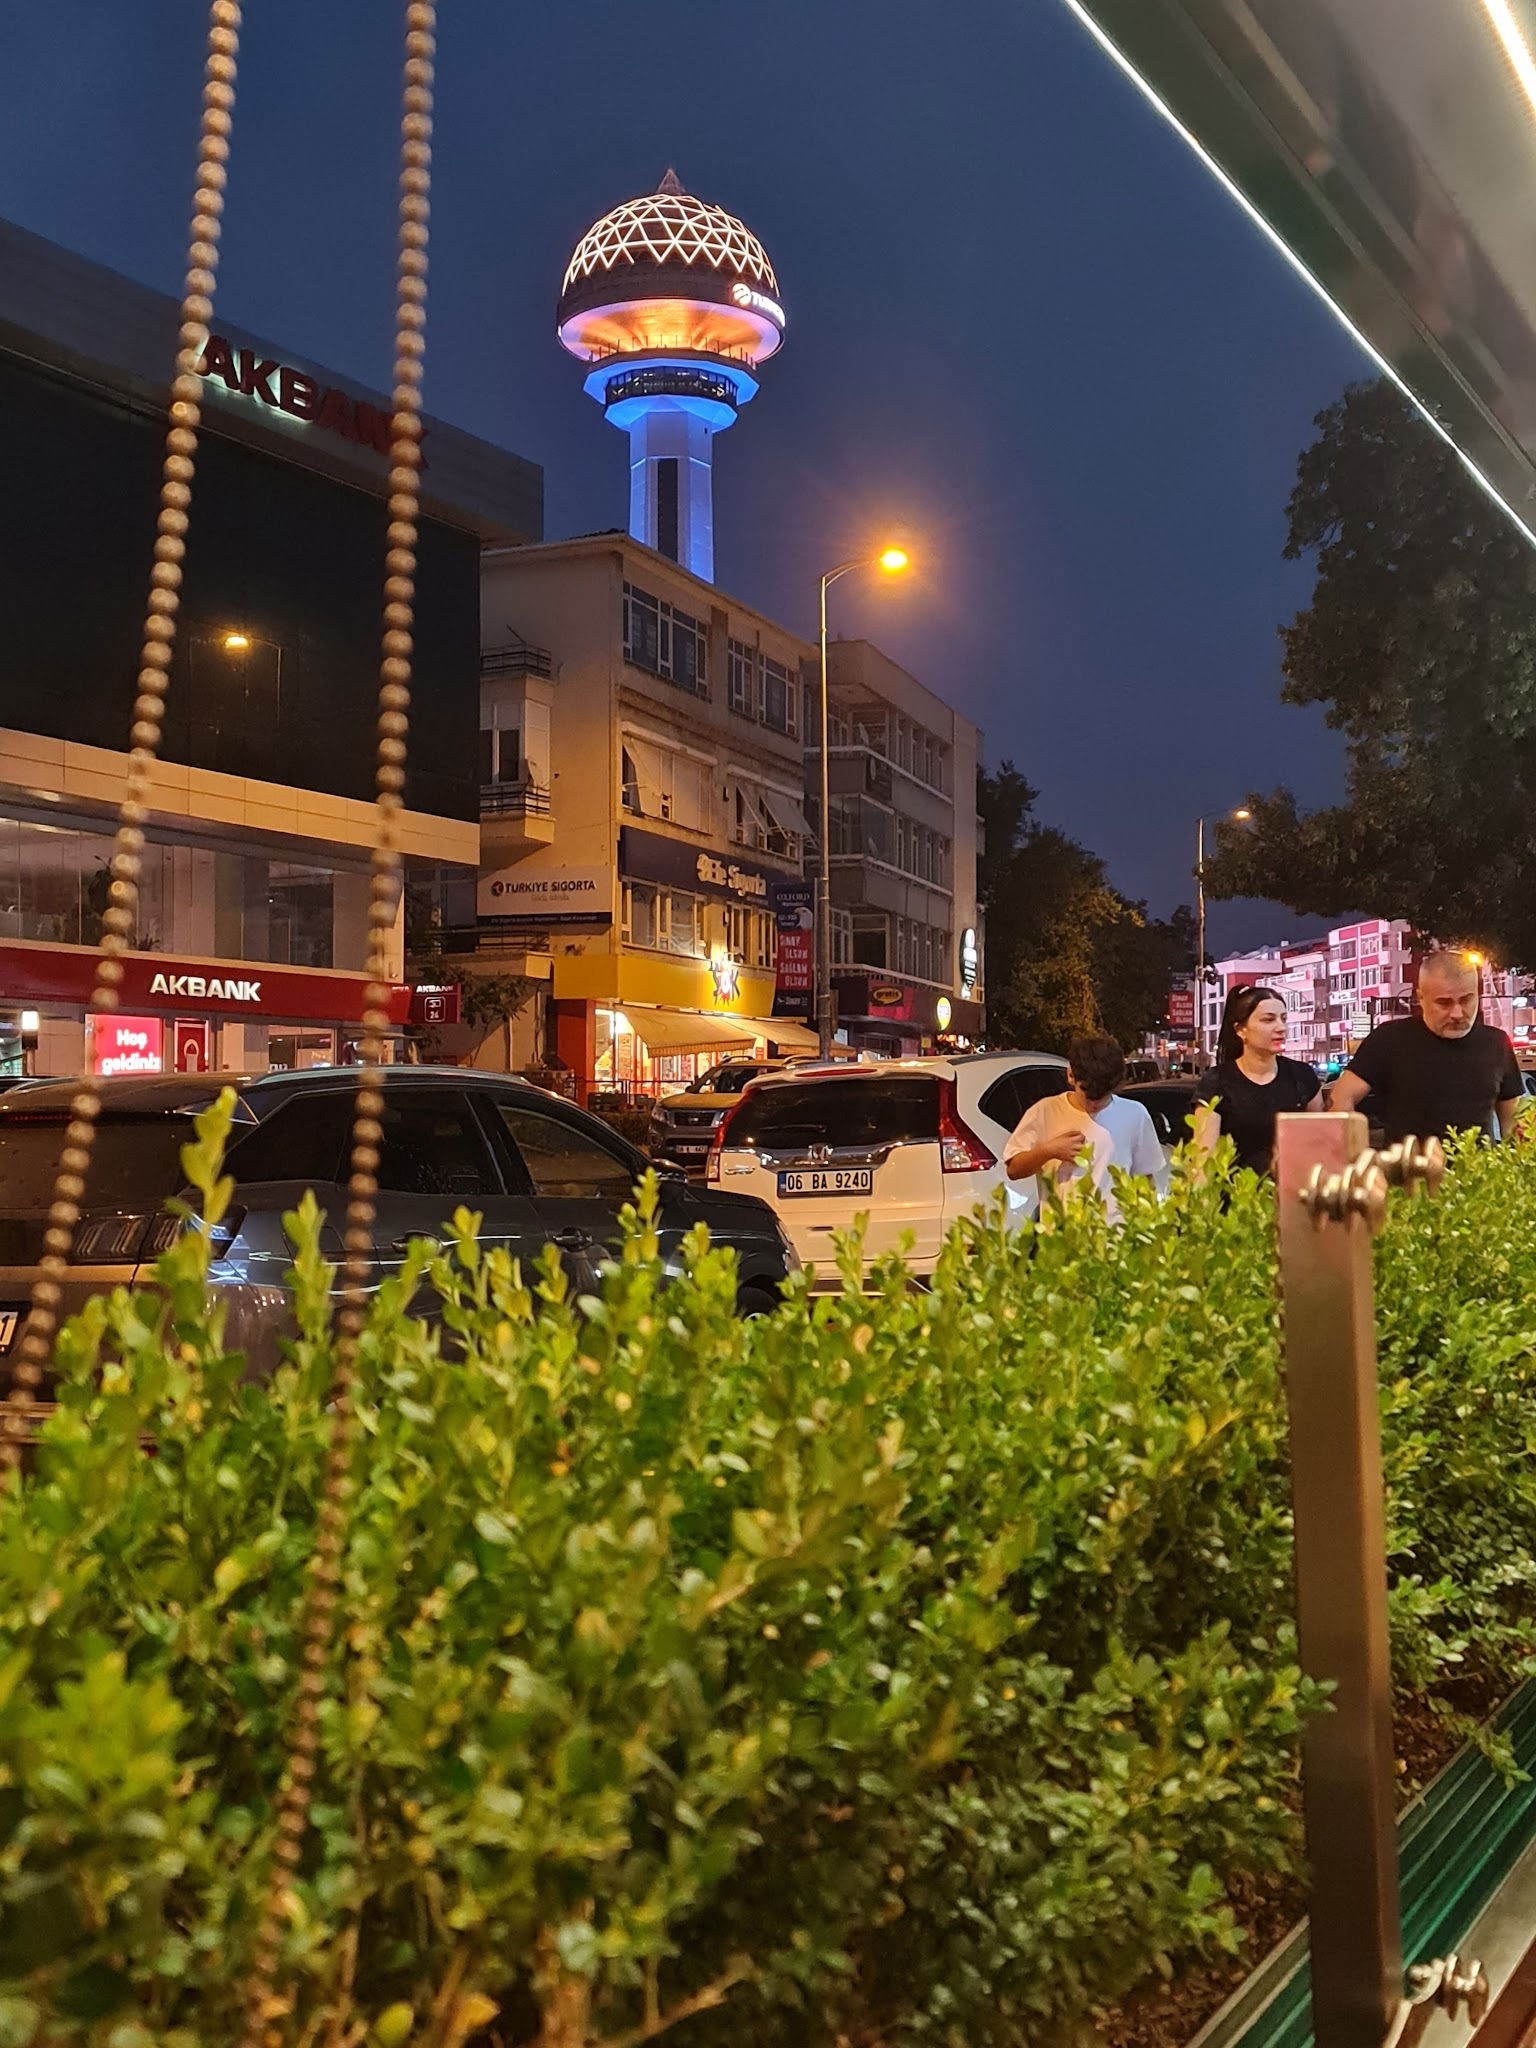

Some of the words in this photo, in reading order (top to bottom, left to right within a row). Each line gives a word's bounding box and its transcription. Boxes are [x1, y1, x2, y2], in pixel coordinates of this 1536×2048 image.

[201, 335, 428, 470] AKBAN
[149, 973, 262, 1002] AKBANK
[416, 985, 455, 993] AKBANK
[117, 1029, 147, 1050] Hoş
[787, 1175, 803, 1191] 06
[812, 1174, 828, 1190] BA
[835, 1172, 869, 1188] 9240
